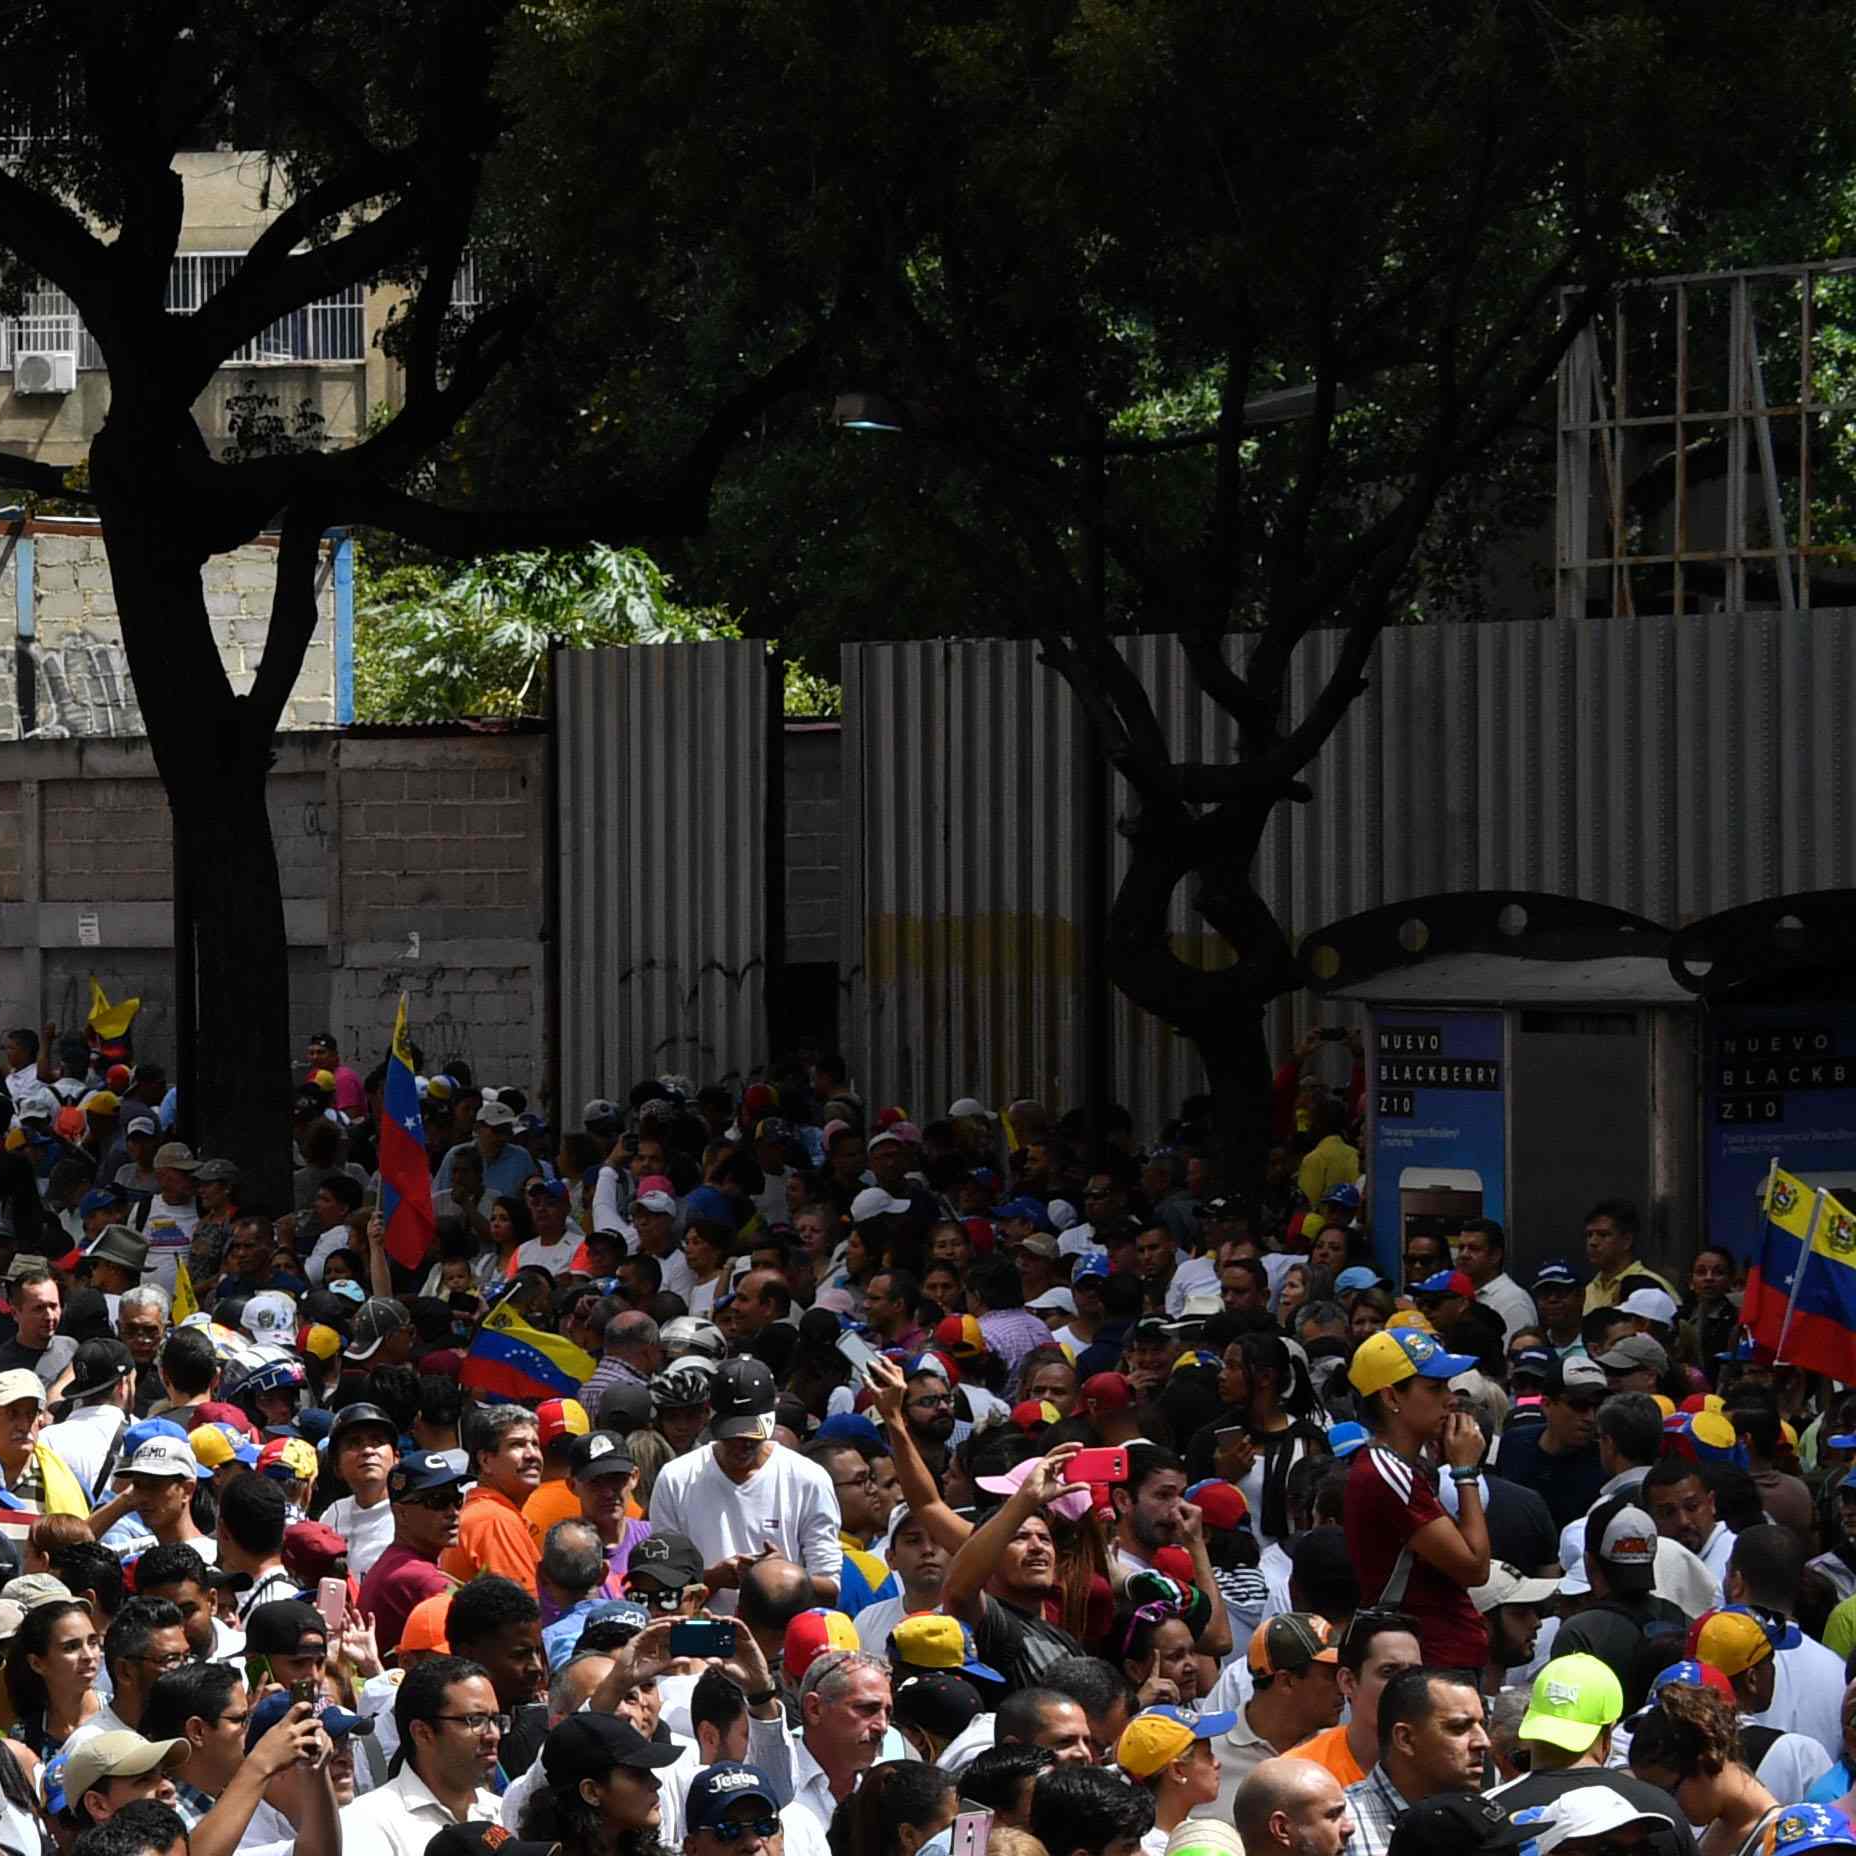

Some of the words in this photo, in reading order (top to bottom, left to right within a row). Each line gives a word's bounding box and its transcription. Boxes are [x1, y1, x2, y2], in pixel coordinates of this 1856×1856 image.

[1380, 1034, 1439, 1050] NUEVO
[1722, 1033, 1829, 1057] NUEVO
[1380, 1064, 1497, 1083] BLACKBERRY
[1380, 1096, 1411, 1113] Z10
[1721, 1100, 1777, 1121] Z10
